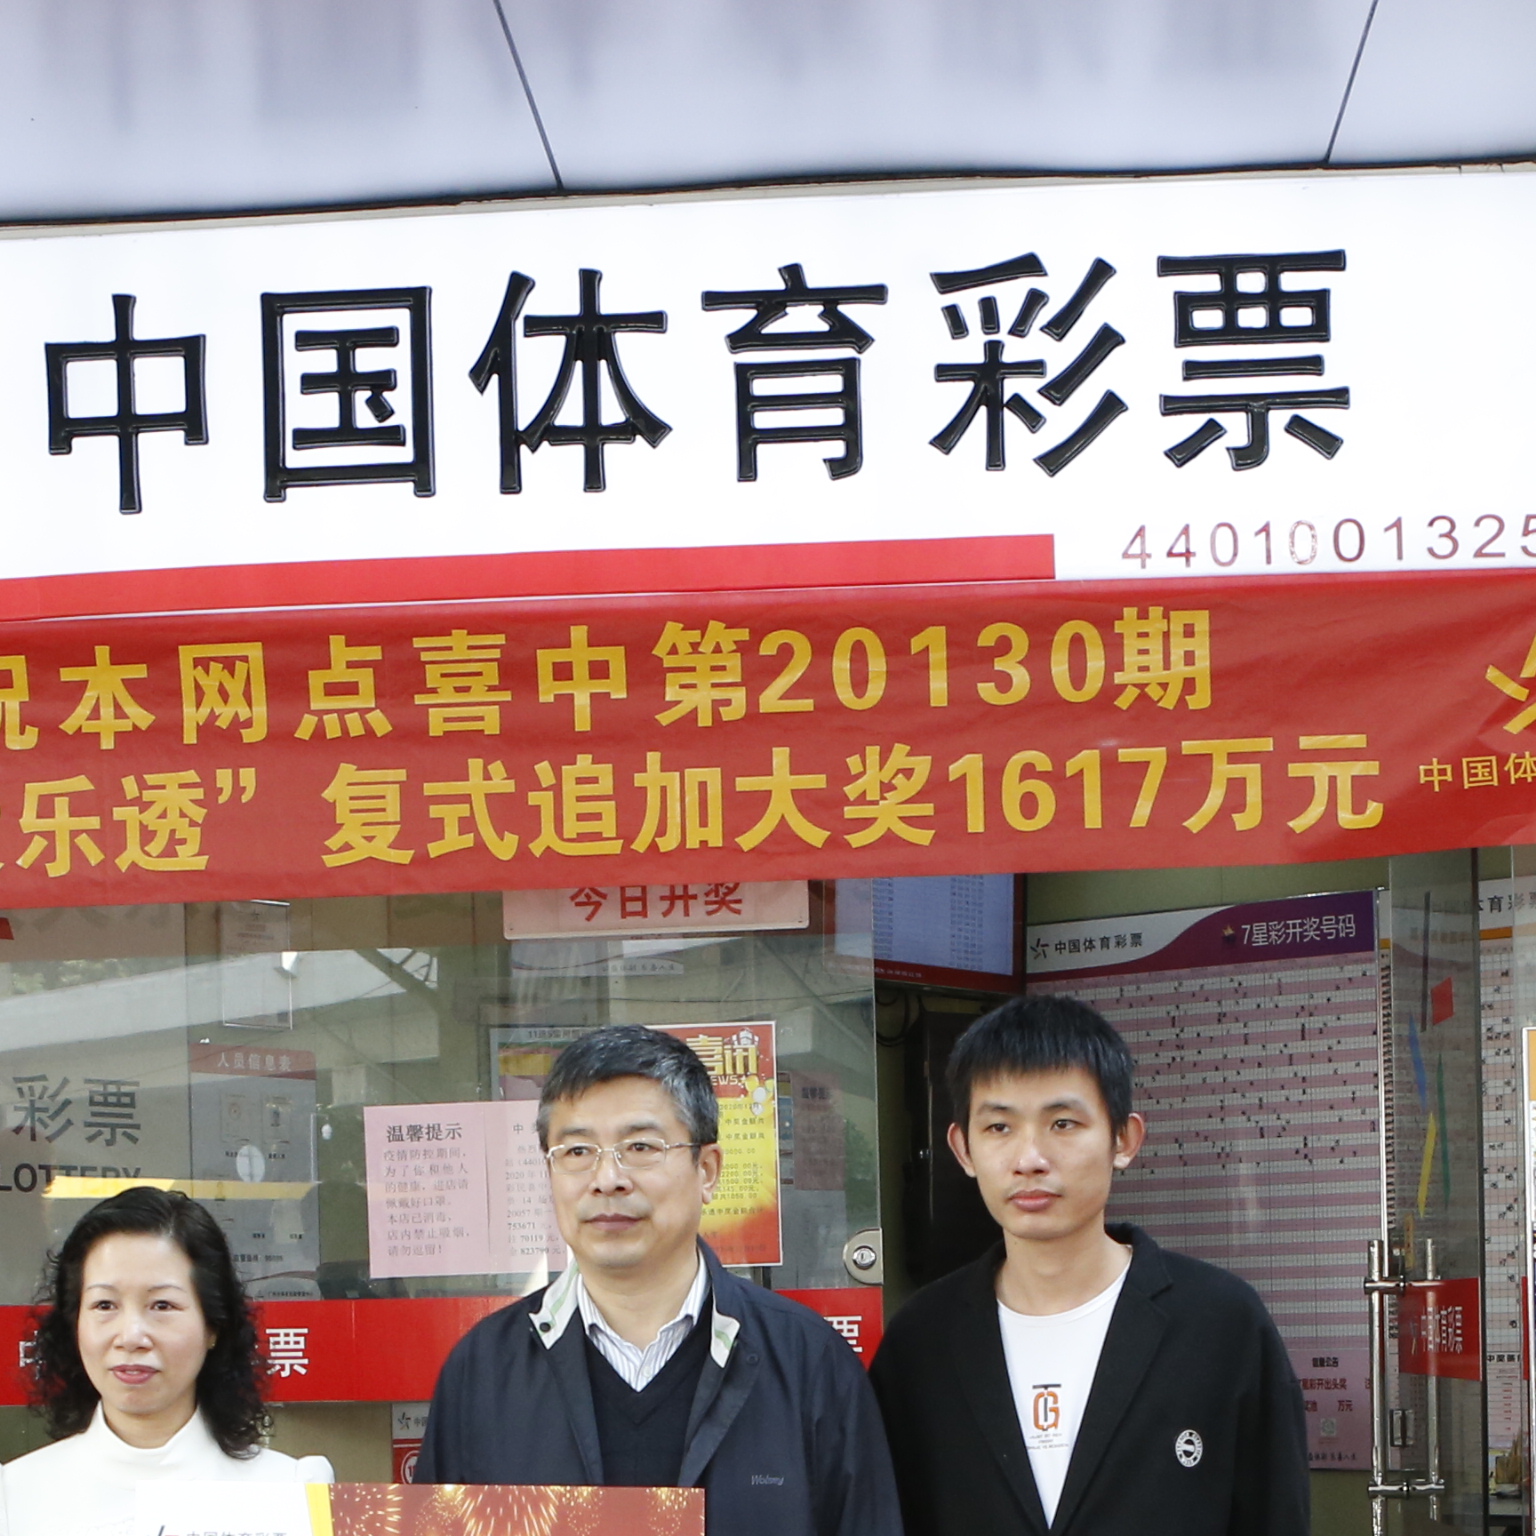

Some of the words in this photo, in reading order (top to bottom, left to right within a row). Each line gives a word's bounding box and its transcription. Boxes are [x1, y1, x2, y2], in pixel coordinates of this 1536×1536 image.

[44, 248, 1350, 514] 中国体育彩票
[320, 734, 1384, 865] 复式追加大奖1617万元
[569, 884, 743, 922] 今日开奖
[1054, 932, 1143, 955] 中国体育彩票
[1241, 914, 1356, 945] 7星彩开奖号码
[217, 1052, 292, 1072] 人员信息表
[710, 1075, 738, 1087] EWS
[386, 1122, 462, 1143] 温馨提示
